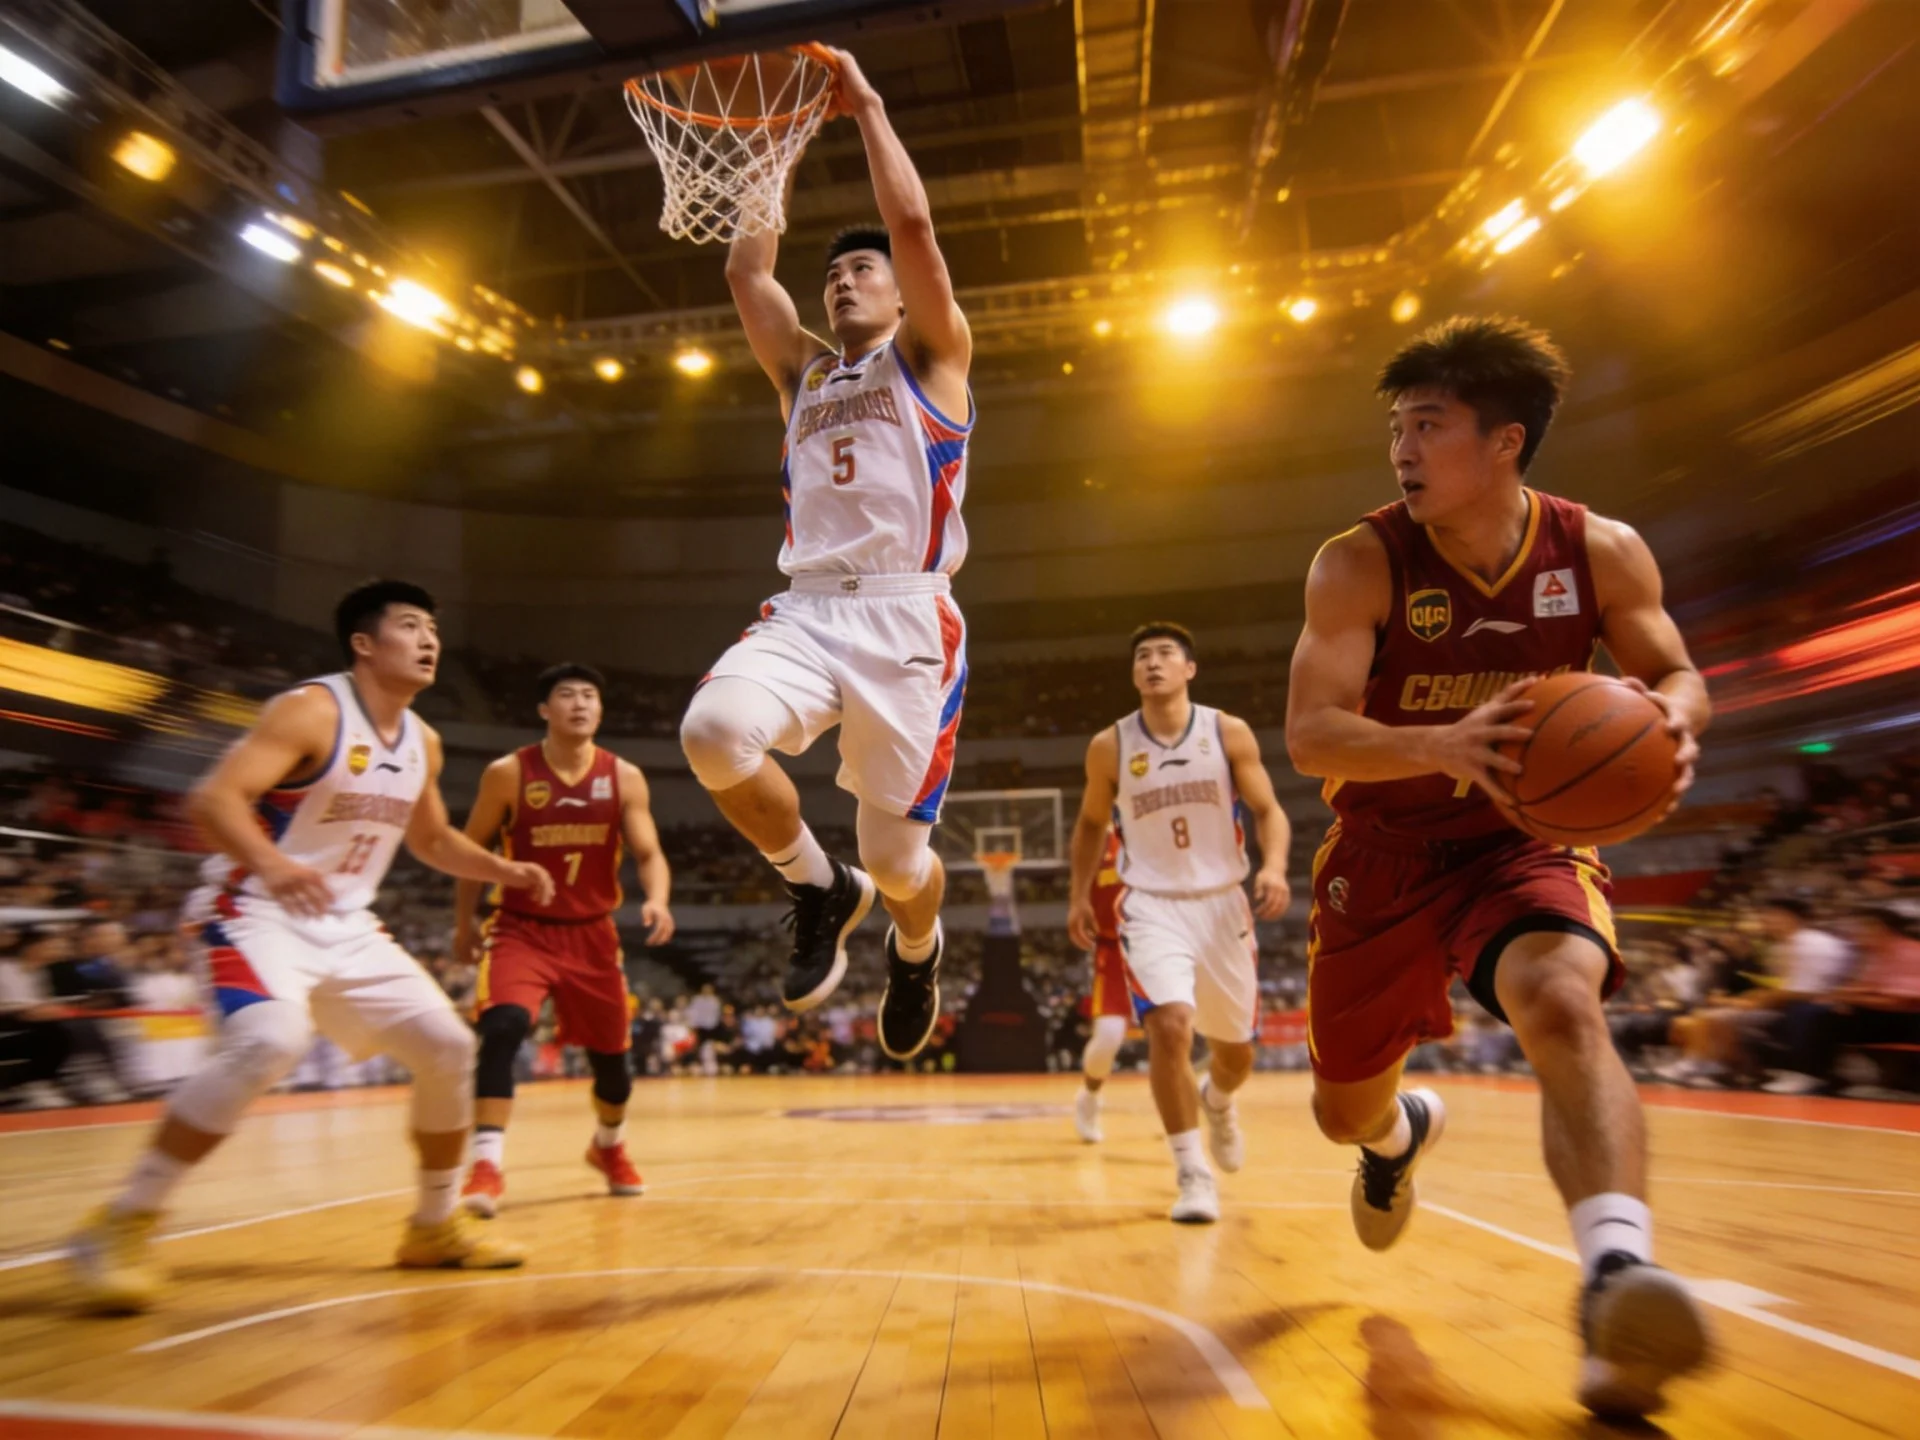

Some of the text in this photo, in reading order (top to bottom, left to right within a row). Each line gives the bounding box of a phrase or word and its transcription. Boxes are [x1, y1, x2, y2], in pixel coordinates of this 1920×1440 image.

[831, 436, 856, 486] 5
[1171, 816, 1190, 850] 8
[563, 852, 583, 886] 7
